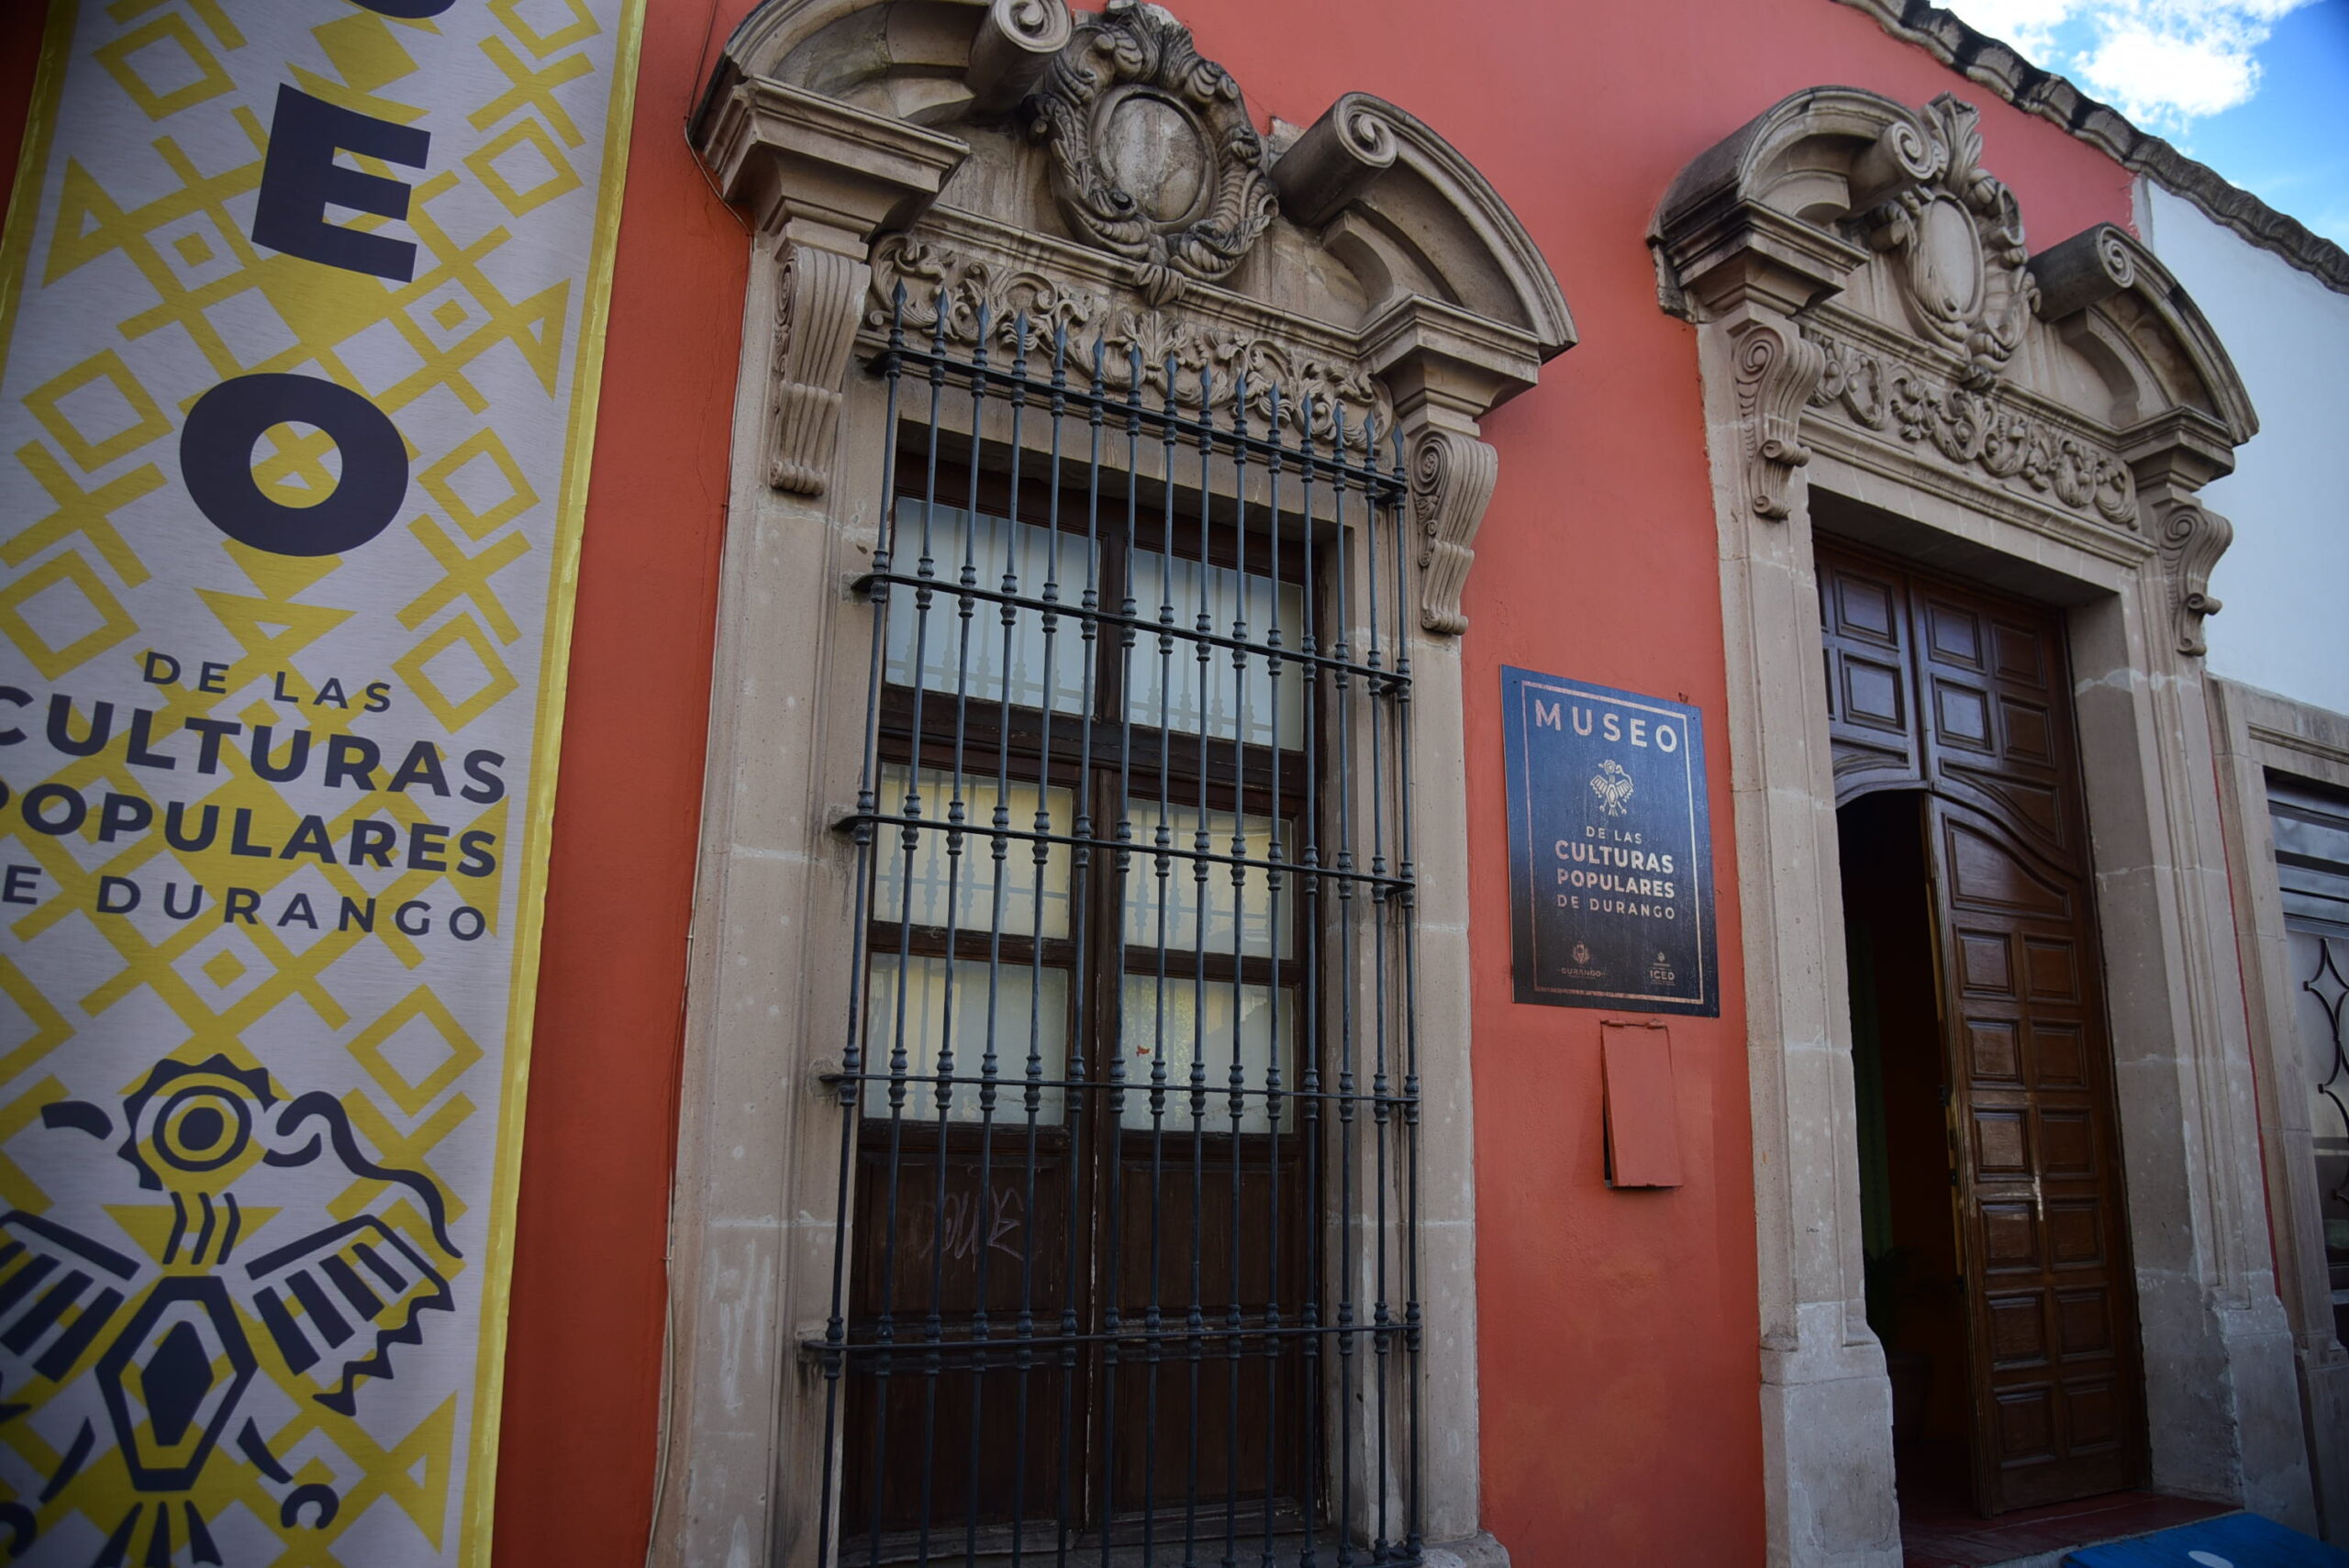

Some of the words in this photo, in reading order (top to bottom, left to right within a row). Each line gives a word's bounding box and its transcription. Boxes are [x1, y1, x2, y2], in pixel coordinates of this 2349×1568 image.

[180, 0, 457, 558] EO
[143, 651, 229, 695] DE
[273, 671, 391, 713] LAS
[1535, 699, 1677, 753] MUSEO
[0, 777, 496, 878] OPULARES
[1586, 825, 1606, 840] DE
[1614, 829, 1642, 845] LAS
[1554, 840, 1674, 874] CULTURAS
[1557, 867, 1675, 899] POPULARES
[95, 874, 486, 941] DURANGO
[1557, 894, 1580, 909] DE
[1589, 897, 1675, 920] DURANGO
[1561, 968, 1602, 977] DURANGO
[1649, 970, 1675, 981] ICED
